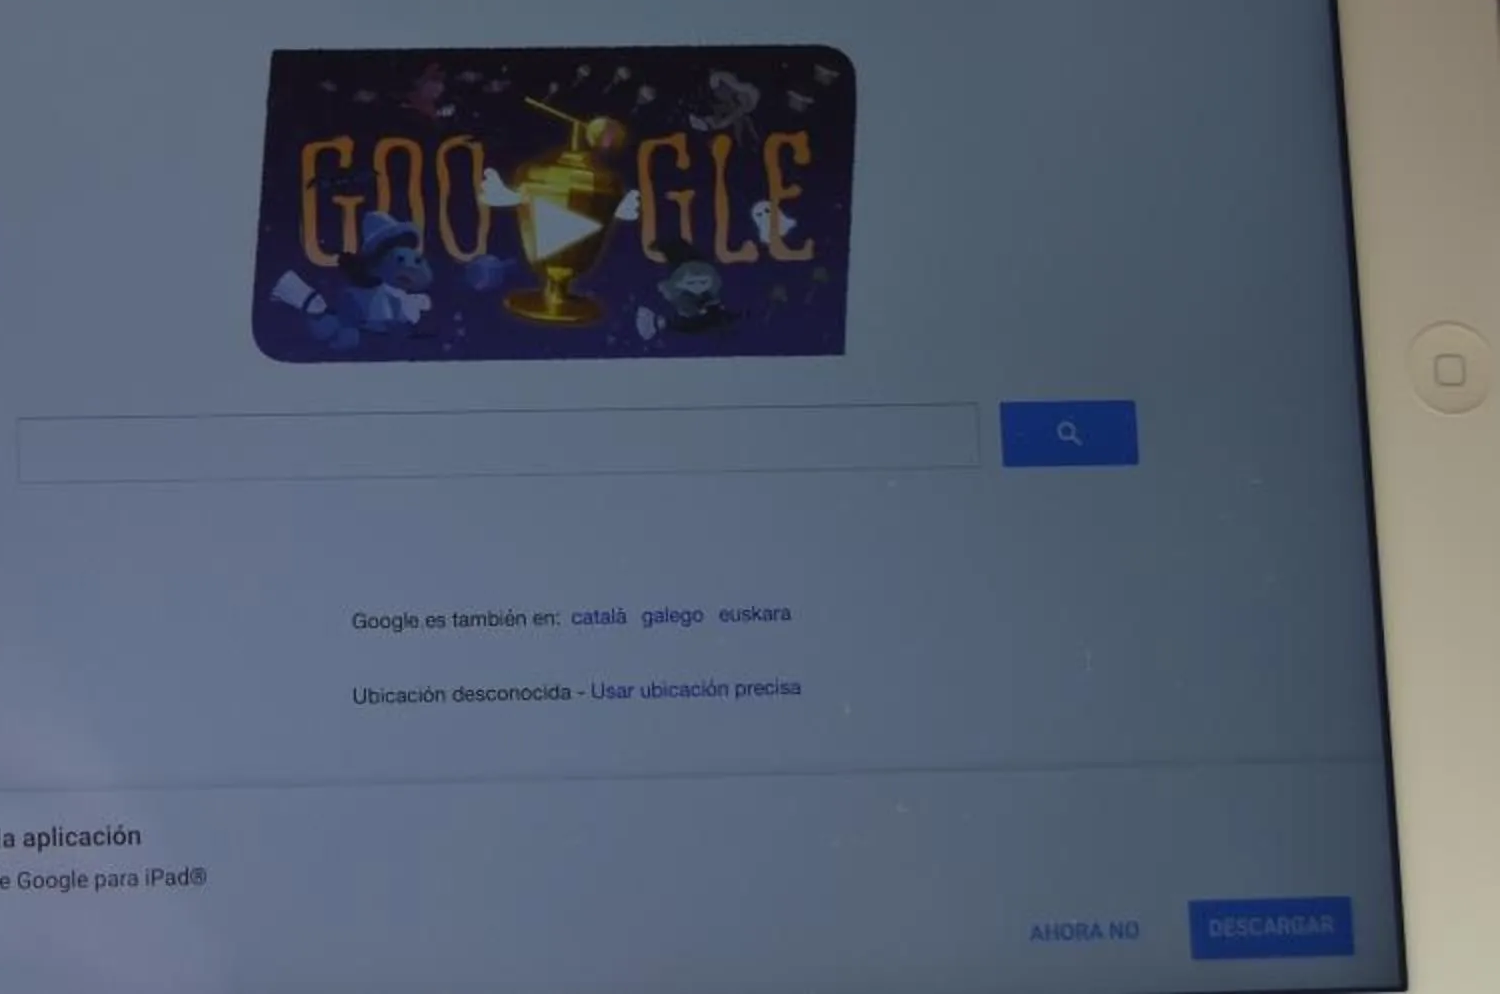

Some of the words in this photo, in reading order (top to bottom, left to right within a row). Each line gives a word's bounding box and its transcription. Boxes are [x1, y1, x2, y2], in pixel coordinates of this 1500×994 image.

[453, 608, 526, 629] también
[533, 611, 561, 626] en:
[642, 606, 704, 628] galego
[719, 606, 792, 622] euskara
[353, 685, 445, 705] Ubicación
[453, 684, 571, 702] desconocida
[591, 682, 634, 699] Usar
[640, 679, 729, 700] ubicación
[735, 676, 802, 699] precisa
[22, 823, 142, 852] aplicación
[16, 869, 89, 894] Google
[94, 872, 139, 892] para
[1029, 920, 1104, 942] AHORA
[1109, 919, 1140, 940] NO
[1208, 914, 1335, 938] DESCARGAR
